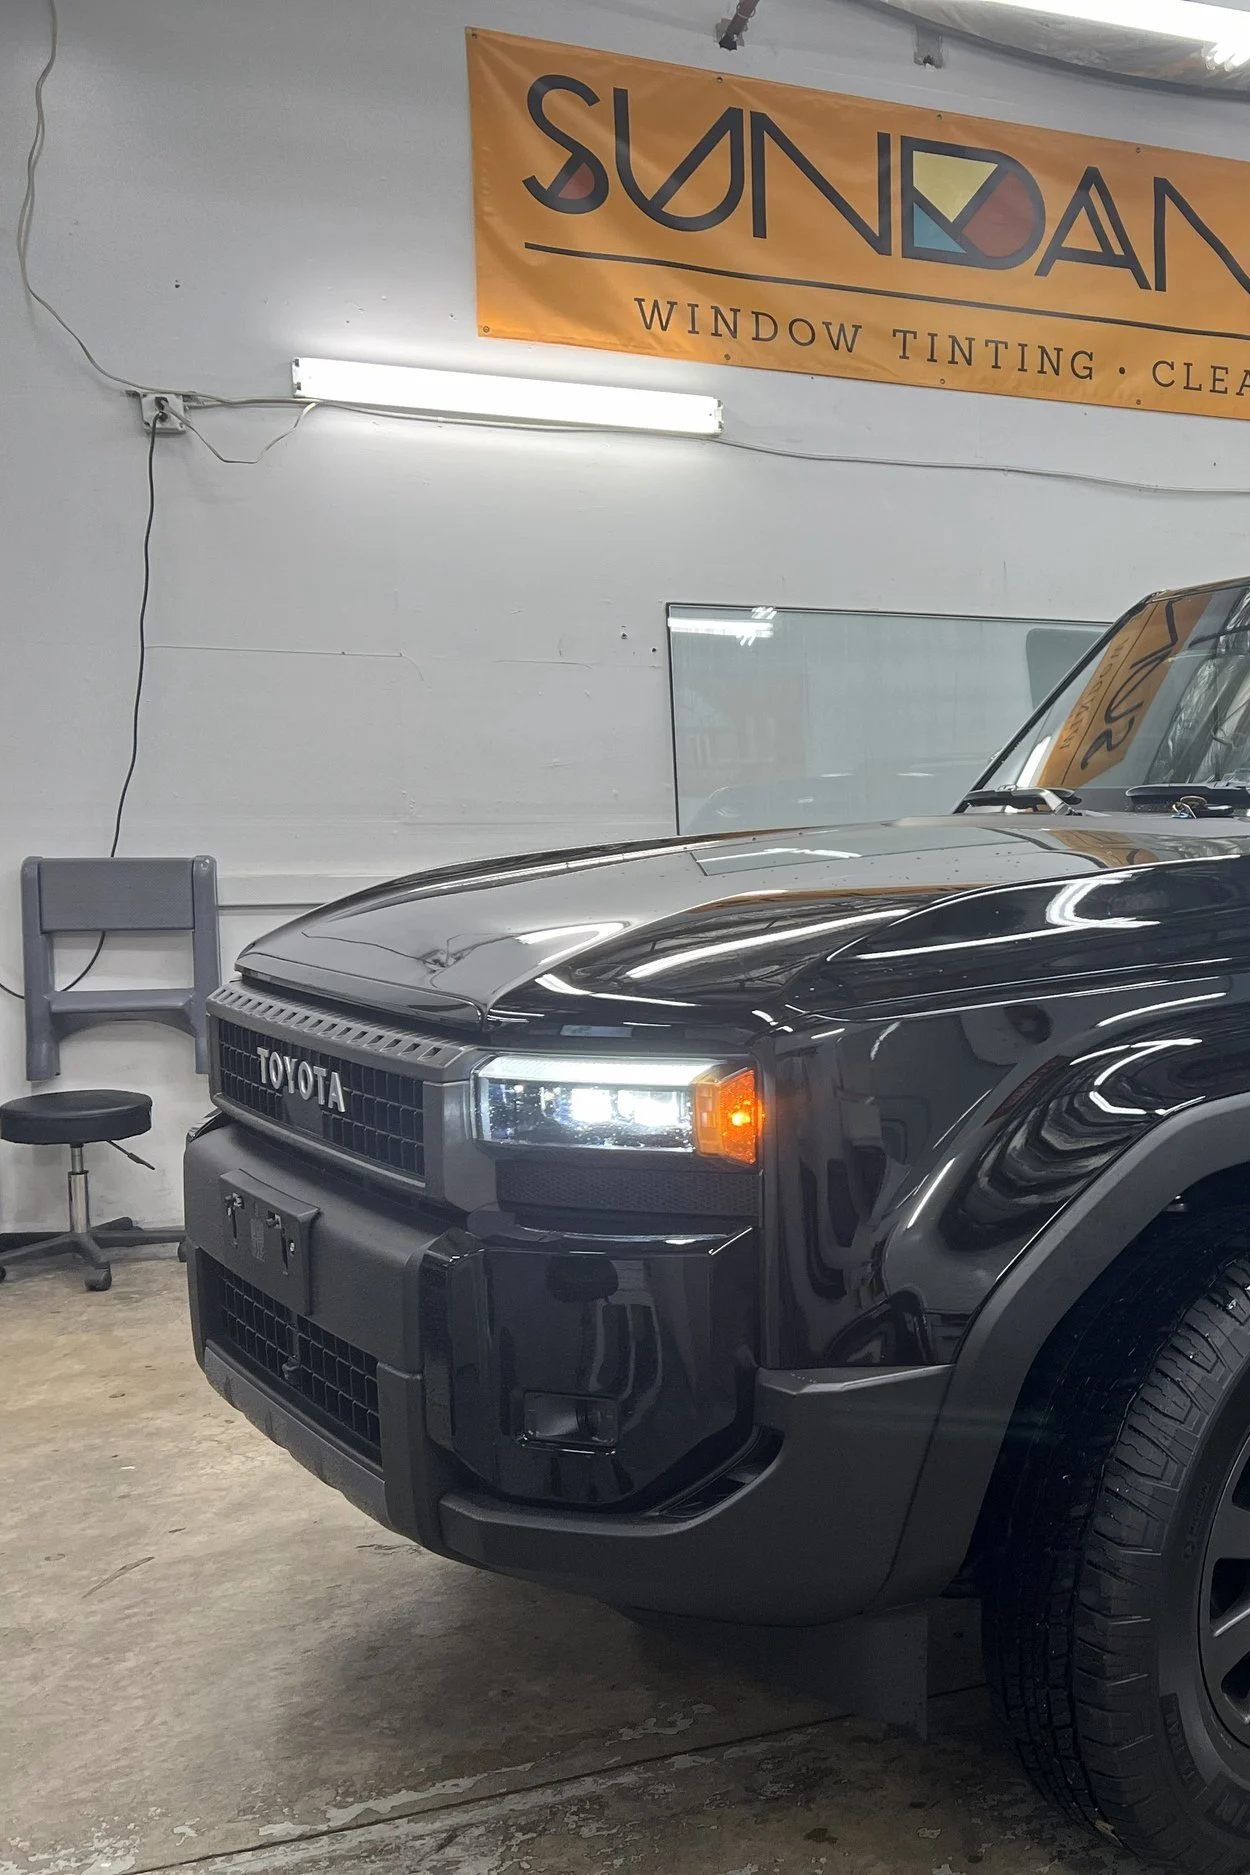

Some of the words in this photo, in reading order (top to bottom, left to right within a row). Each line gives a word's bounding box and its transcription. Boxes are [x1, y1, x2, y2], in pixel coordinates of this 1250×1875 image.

[633, 297, 864, 353] WINDOW
[892, 328, 1096, 381] TINTING
[257, 1046, 346, 1113] TOYOTA
